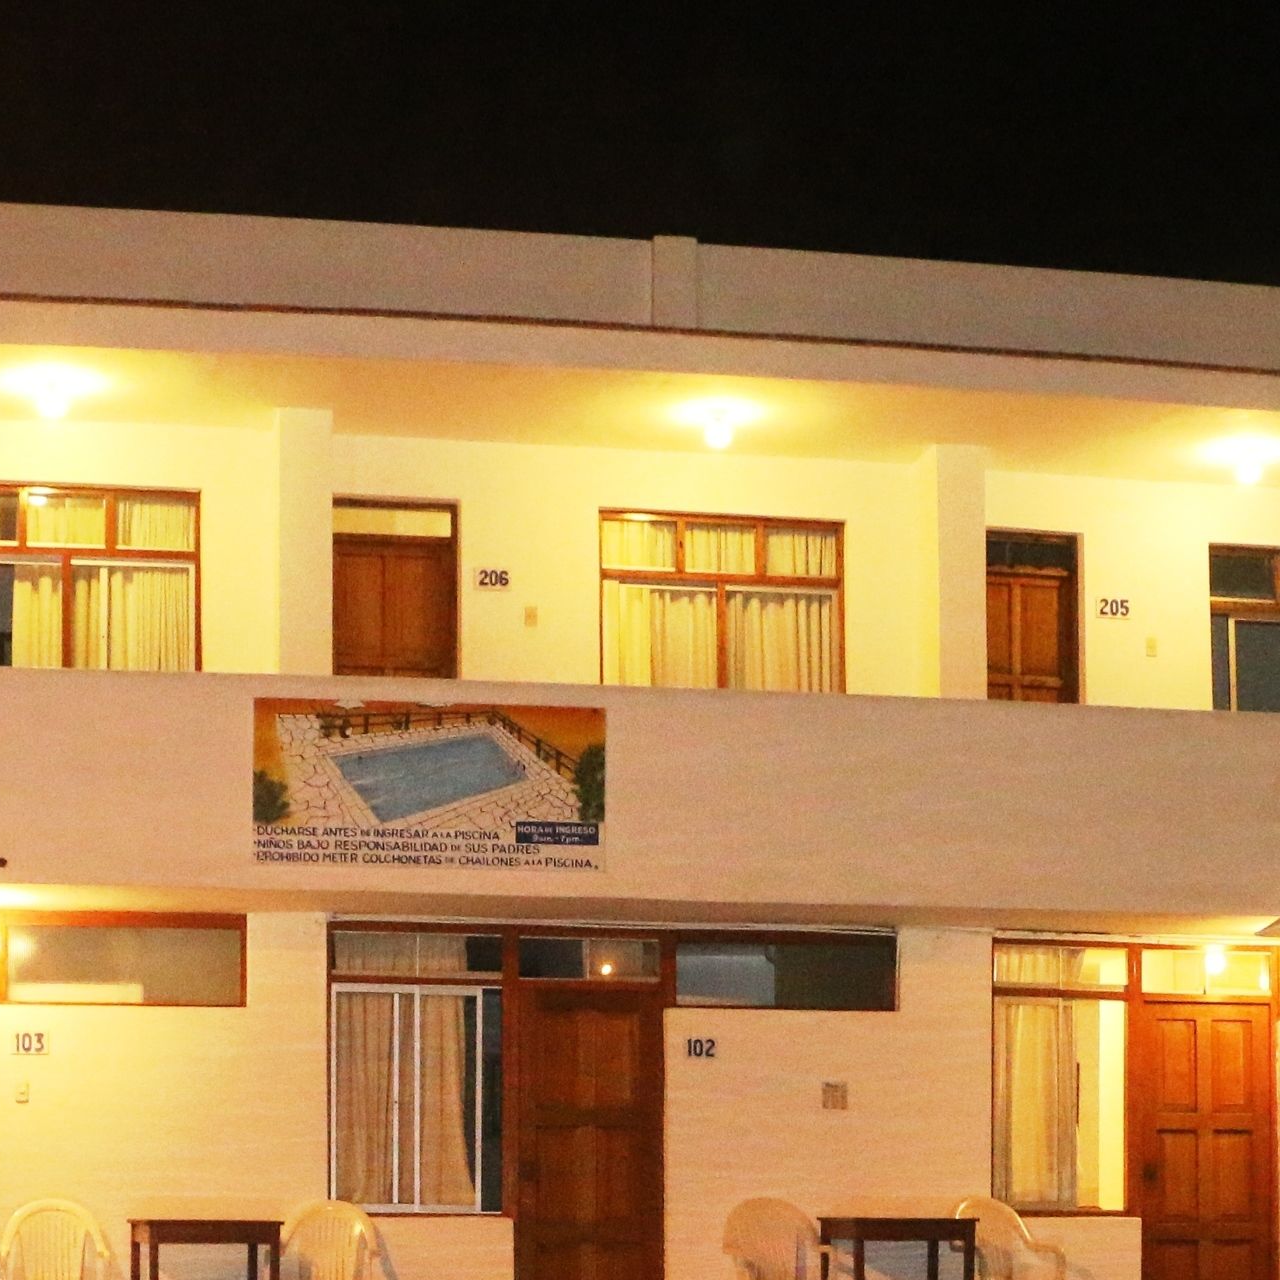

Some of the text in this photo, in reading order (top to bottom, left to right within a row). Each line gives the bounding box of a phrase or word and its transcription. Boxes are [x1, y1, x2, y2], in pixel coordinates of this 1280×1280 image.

[478, 569, 509, 586] 206
[1099, 598, 1129, 616] 205
[256, 826, 318, 836] DUCHARSE
[321, 827, 357, 837] ANTES
[373, 828, 429, 838] INGRESAR
[454, 830, 500, 840] PISCINA
[517, 825, 543, 834] HORA
[556, 825, 596, 835] INGRESO
[257, 837, 540, 854] NIÑOS BAJO RESPONSABILIDAD DE SUS PADRES
[256, 850, 319, 862] PROHIBIDO
[322, 852, 358, 863] METER
[362, 853, 442, 865] COLCHONETAS
[15, 1033, 45, 1053] 103
[687, 1038, 716, 1057] 102
